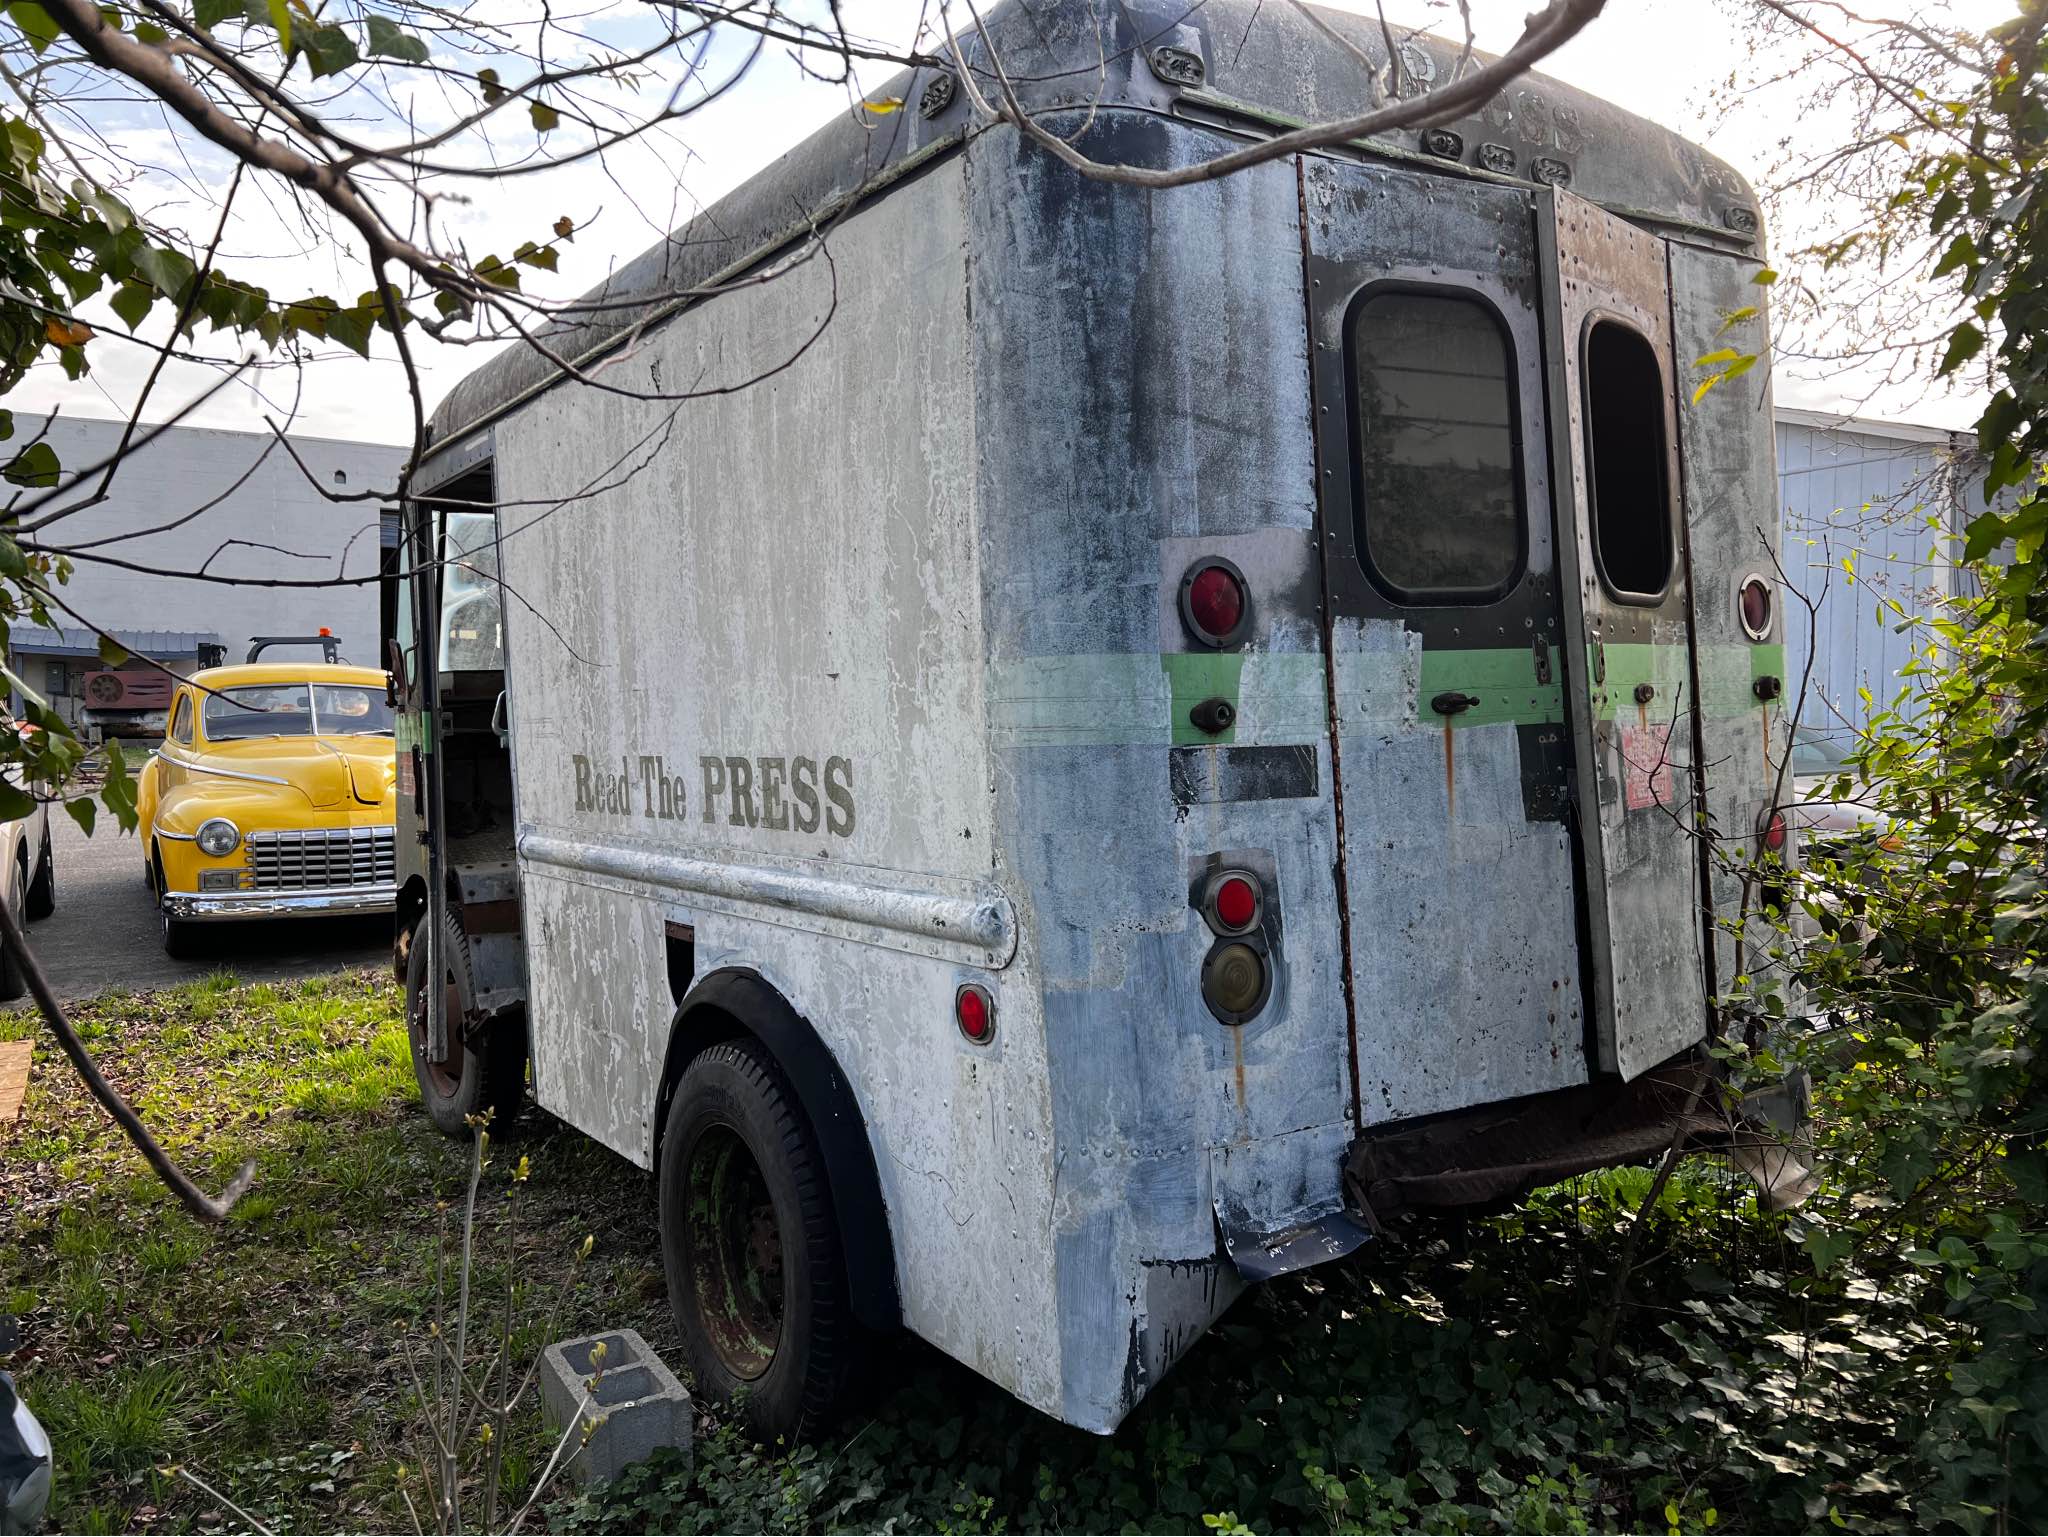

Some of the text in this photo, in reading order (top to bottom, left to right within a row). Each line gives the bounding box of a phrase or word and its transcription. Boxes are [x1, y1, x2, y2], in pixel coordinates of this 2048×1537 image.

[572, 754, 857, 838] Read The PRESS
